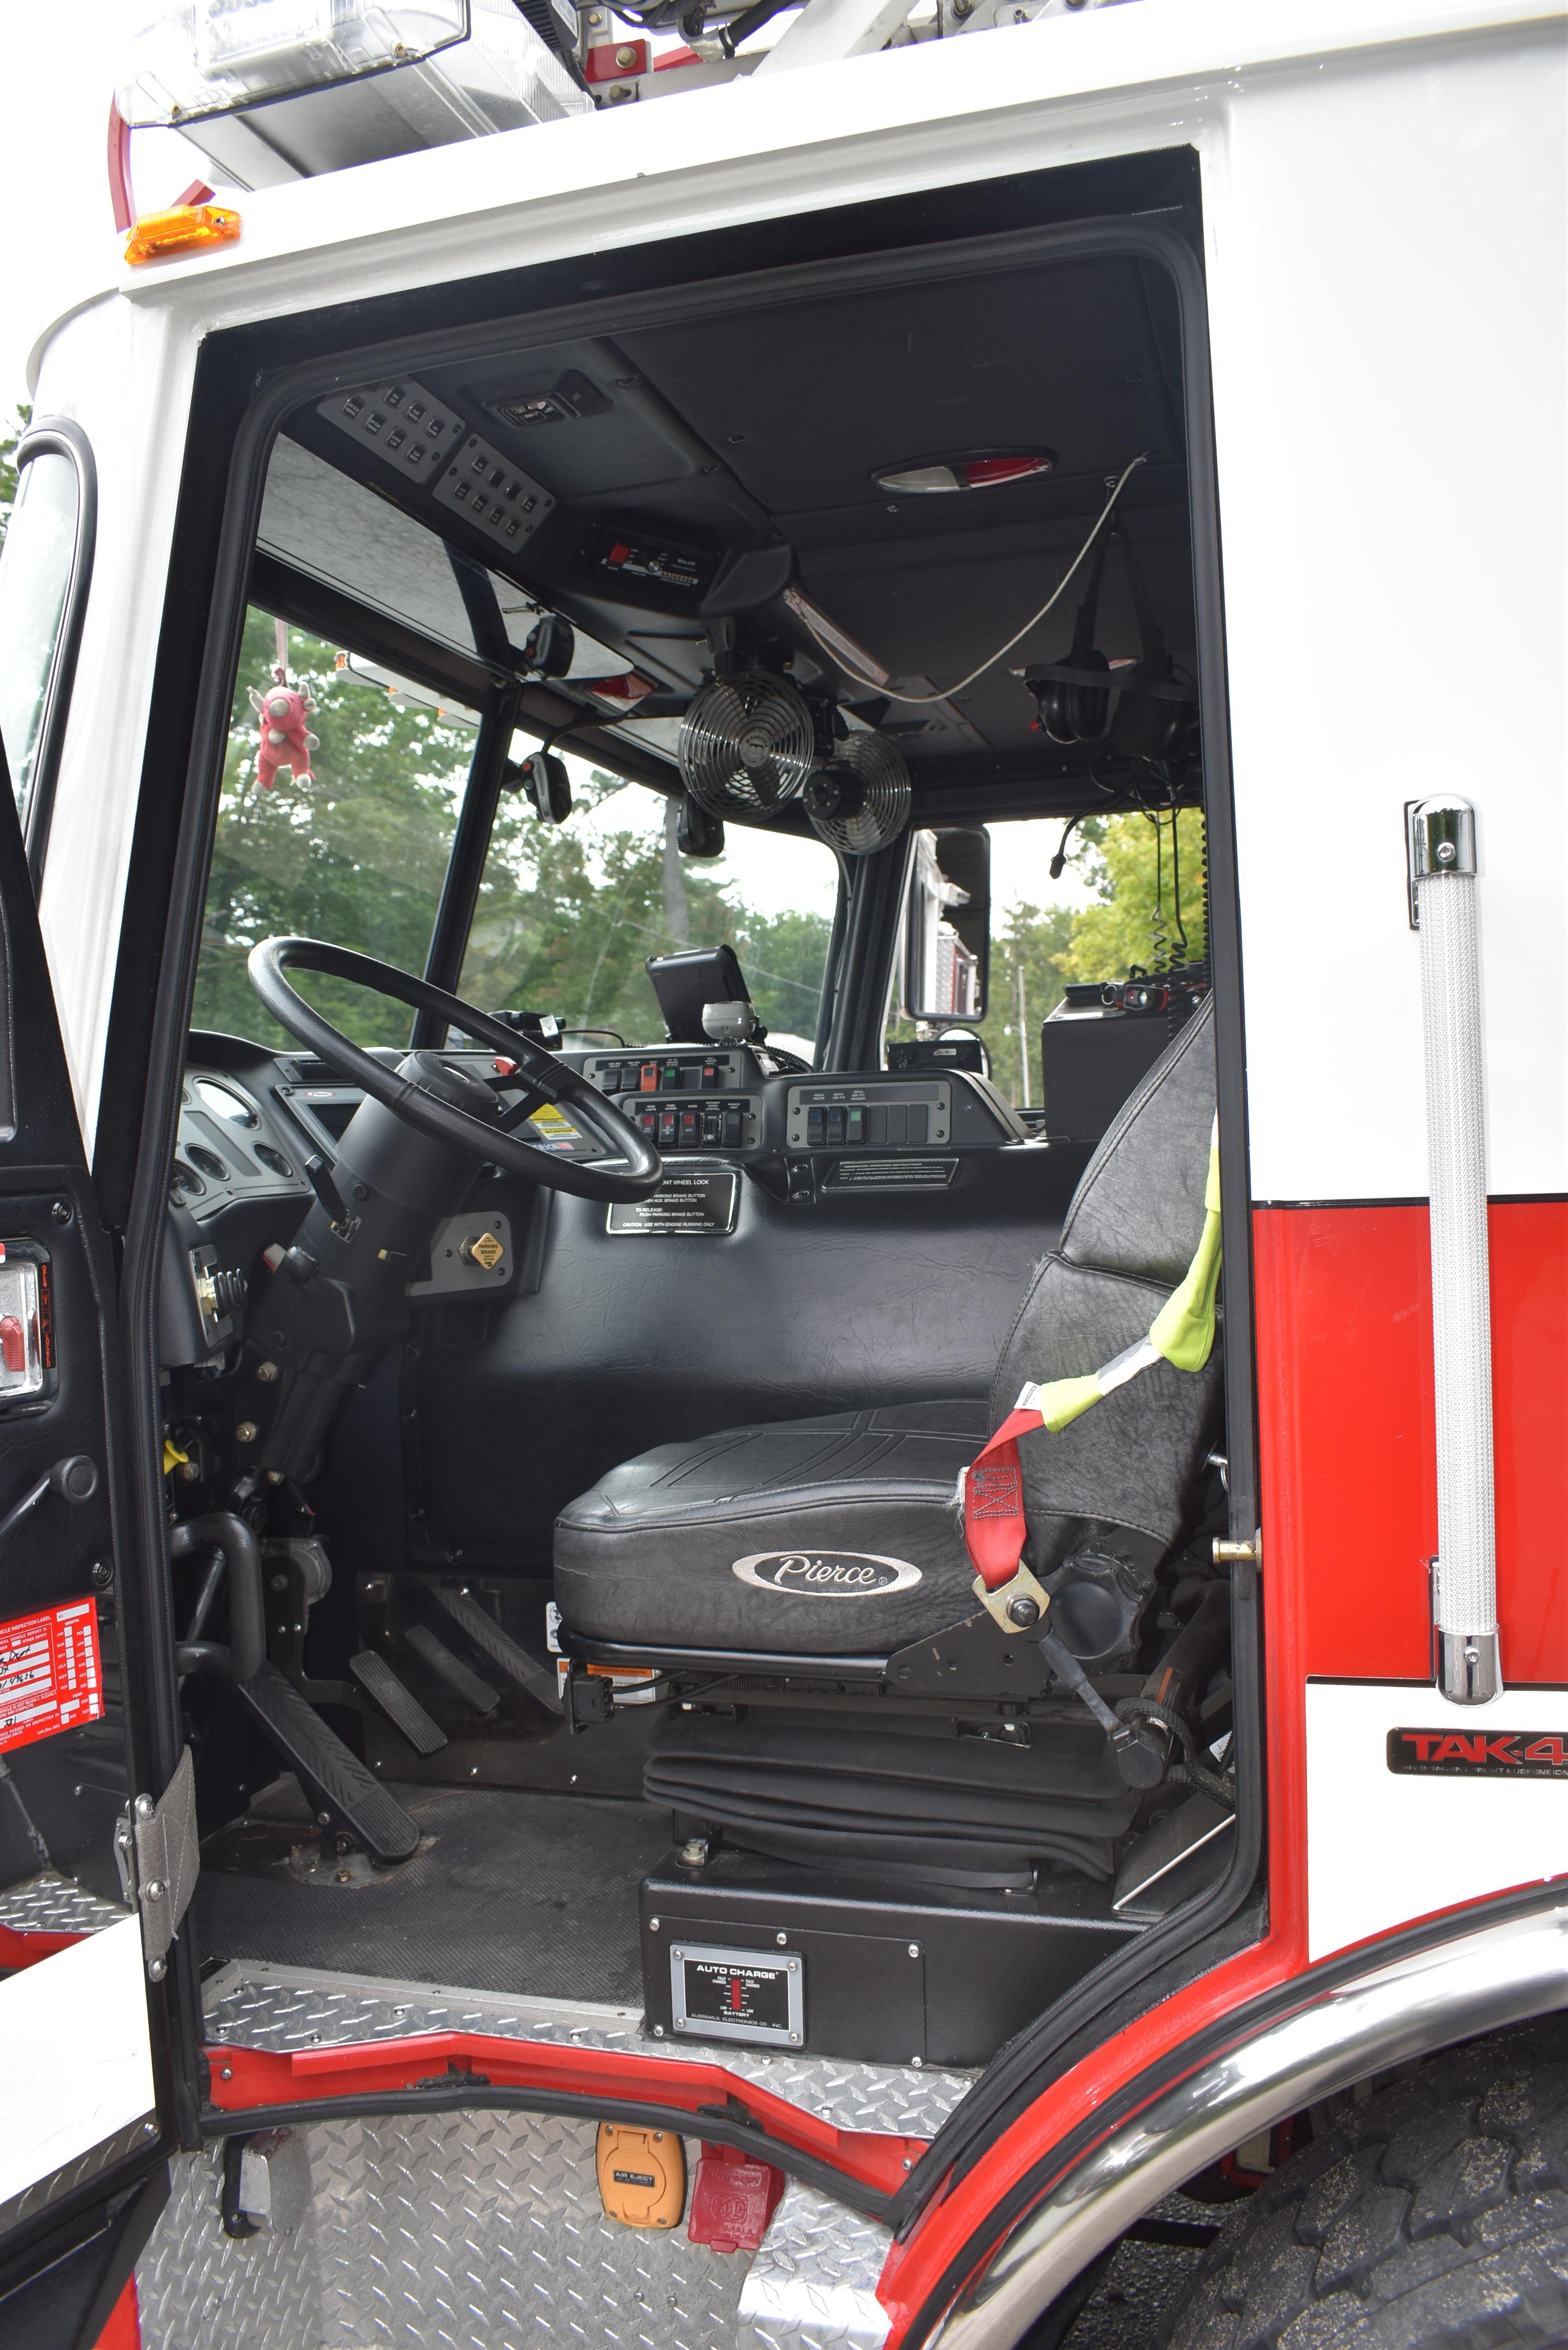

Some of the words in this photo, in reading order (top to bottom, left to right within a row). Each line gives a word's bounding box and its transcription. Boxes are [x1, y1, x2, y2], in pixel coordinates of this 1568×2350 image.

[774, 1555, 877, 1585] Pierce
[11, 1619, 37, 1631] INSPECTION
[9, 1725, 25, 1733] PASSED
[32, 1715, 54, 1725] INSPECTION
[1401, 1733, 1568, 1765] TAK-4
[697, 1965, 728, 1974] AUTO
[722, 2017, 758, 2025] ELECTRONICS
